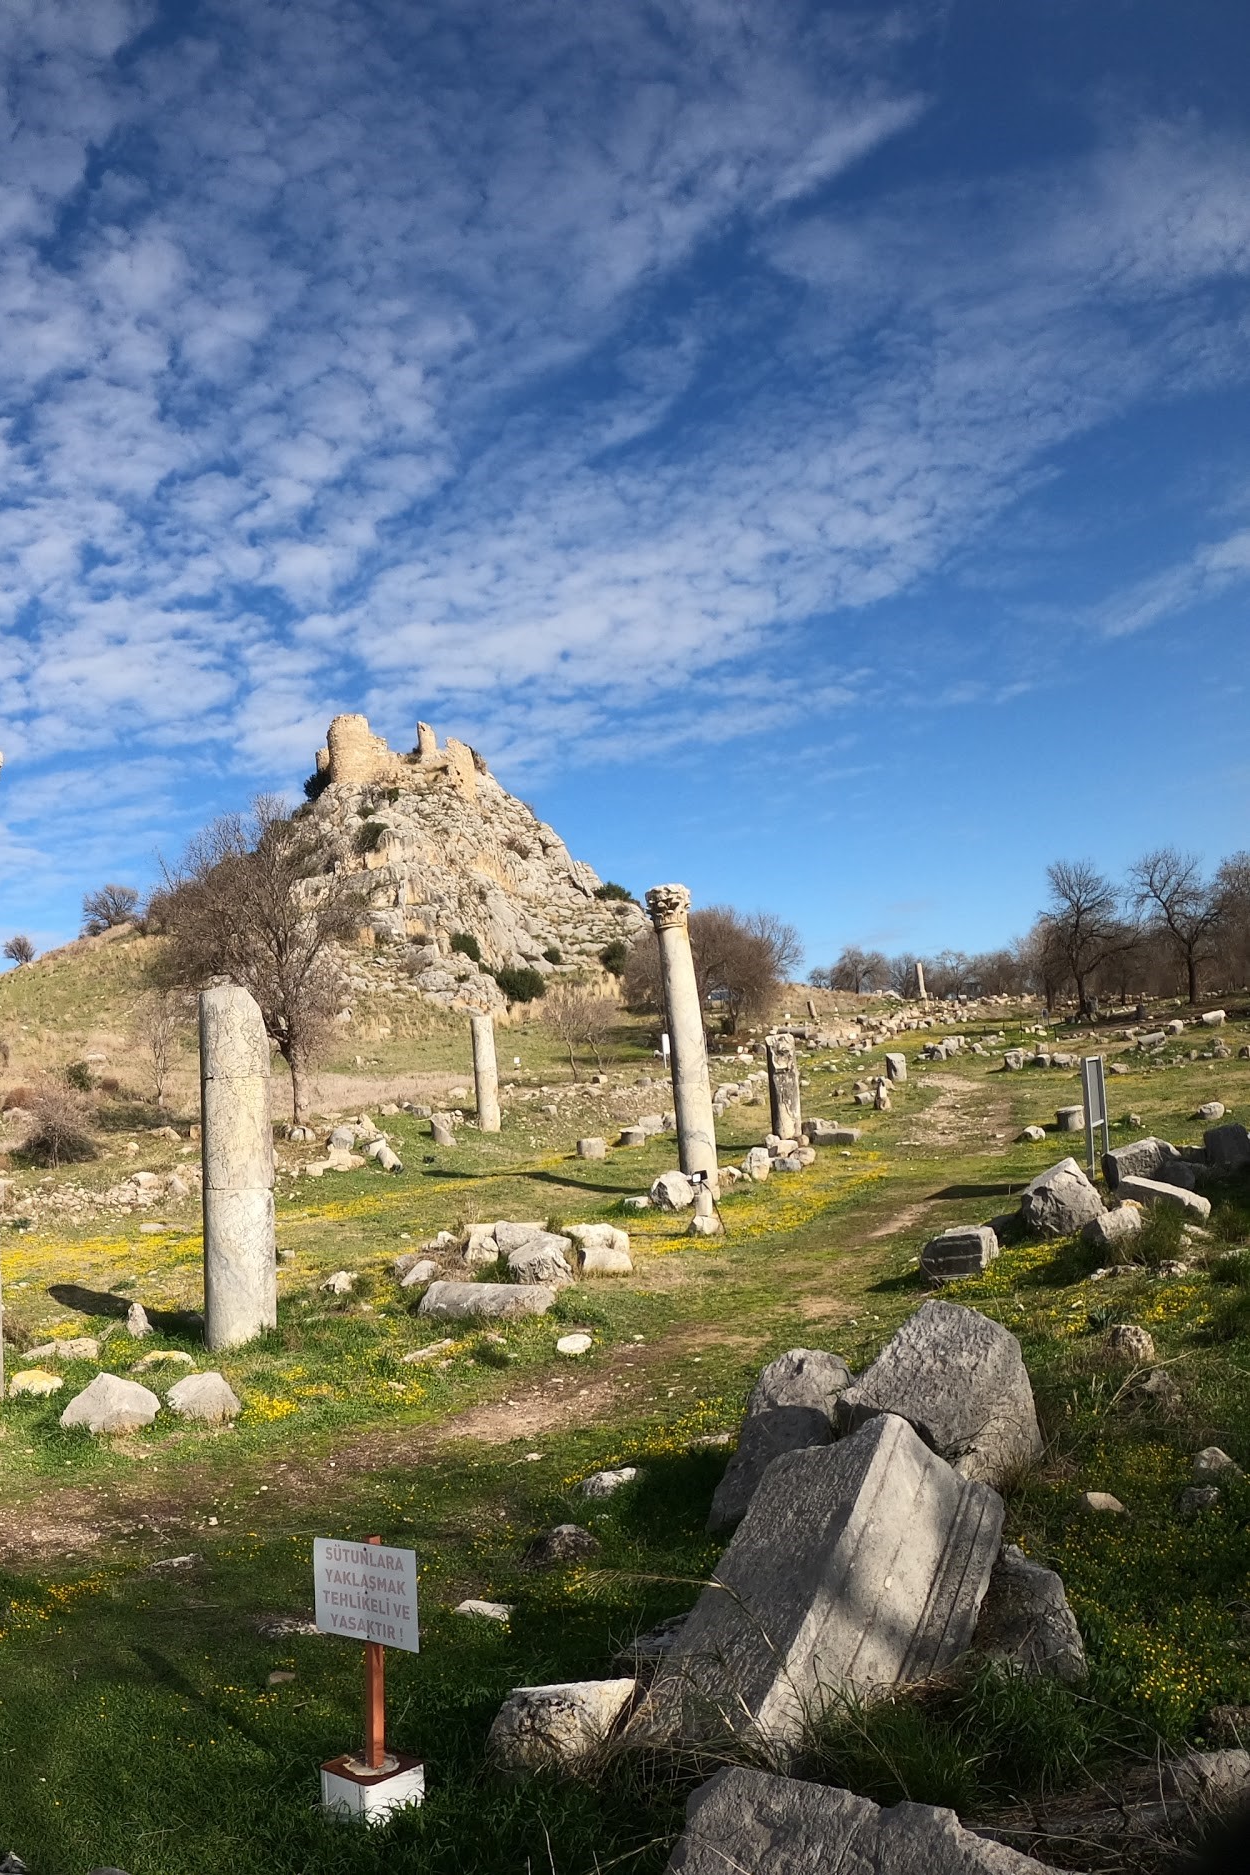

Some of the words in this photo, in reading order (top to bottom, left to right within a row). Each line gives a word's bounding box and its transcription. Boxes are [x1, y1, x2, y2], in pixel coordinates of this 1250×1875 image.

[325, 1544, 404, 1572] SÜTUNLARA
[325, 1568, 406, 1596] YAKLAŞMAK
[323, 1590, 390, 1616] TEHLİKELİ
[393, 1603, 410, 1620] VE
[330, 1613, 396, 1640] YASAKTIR
